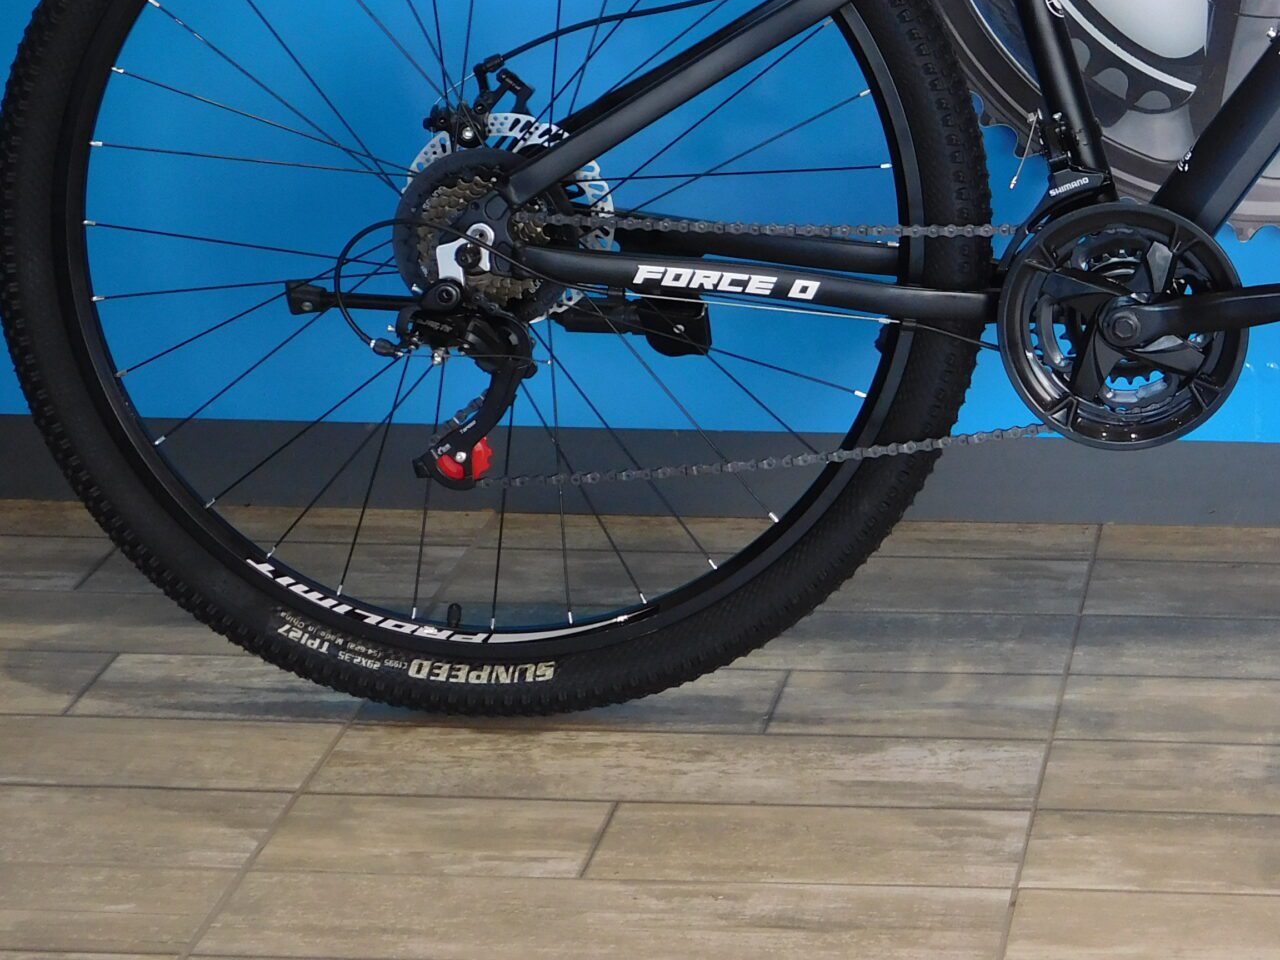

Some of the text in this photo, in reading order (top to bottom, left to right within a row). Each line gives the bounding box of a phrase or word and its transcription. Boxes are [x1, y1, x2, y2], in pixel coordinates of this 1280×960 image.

[1048, 176, 1090, 198] SHIMANO
[632, 264, 778, 296] FORCE
[246, 557, 492, 644] PROLIMIT
[280, 610, 306, 630] China
[277, 623, 329, 654] TPI27
[318, 630, 345, 646] Made
[337, 650, 382, 671] 29X2.35
[407, 658, 556, 685] SUNPEED
